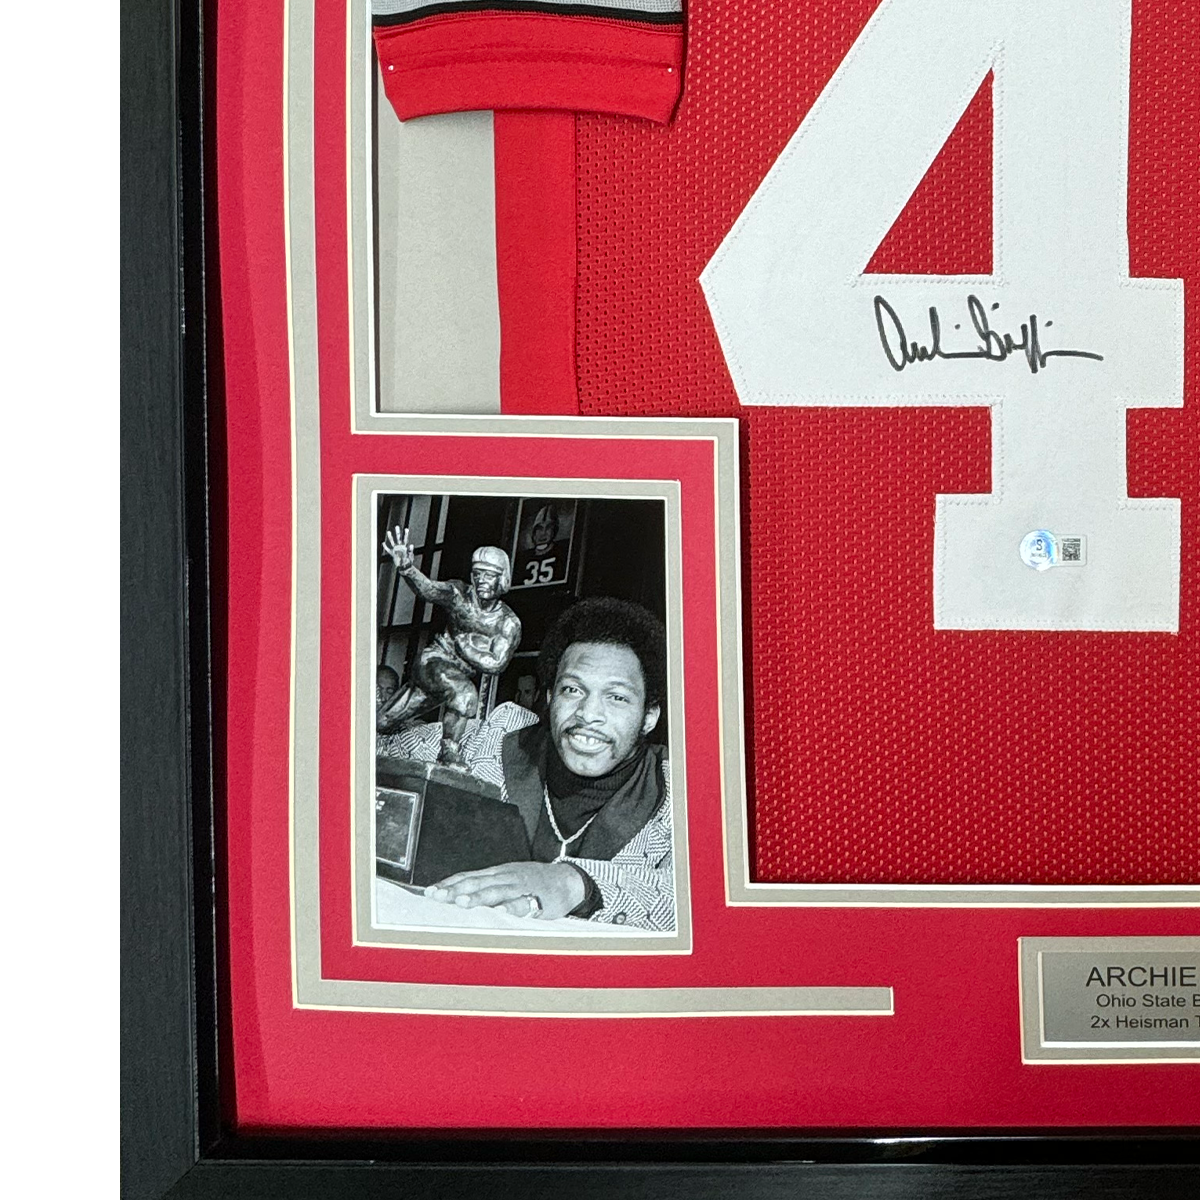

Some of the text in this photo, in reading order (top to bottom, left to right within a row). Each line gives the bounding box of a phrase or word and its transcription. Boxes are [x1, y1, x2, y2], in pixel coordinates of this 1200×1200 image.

[523, 557, 557, 586] 35
[1086, 966, 1197, 987] ARCHIE
[1096, 993, 1137, 1008] Ohio
[1142, 993, 1186, 1008] State
[1090, 1015, 1110, 1029] 2x
[1116, 1014, 1189, 1029] Heisman
